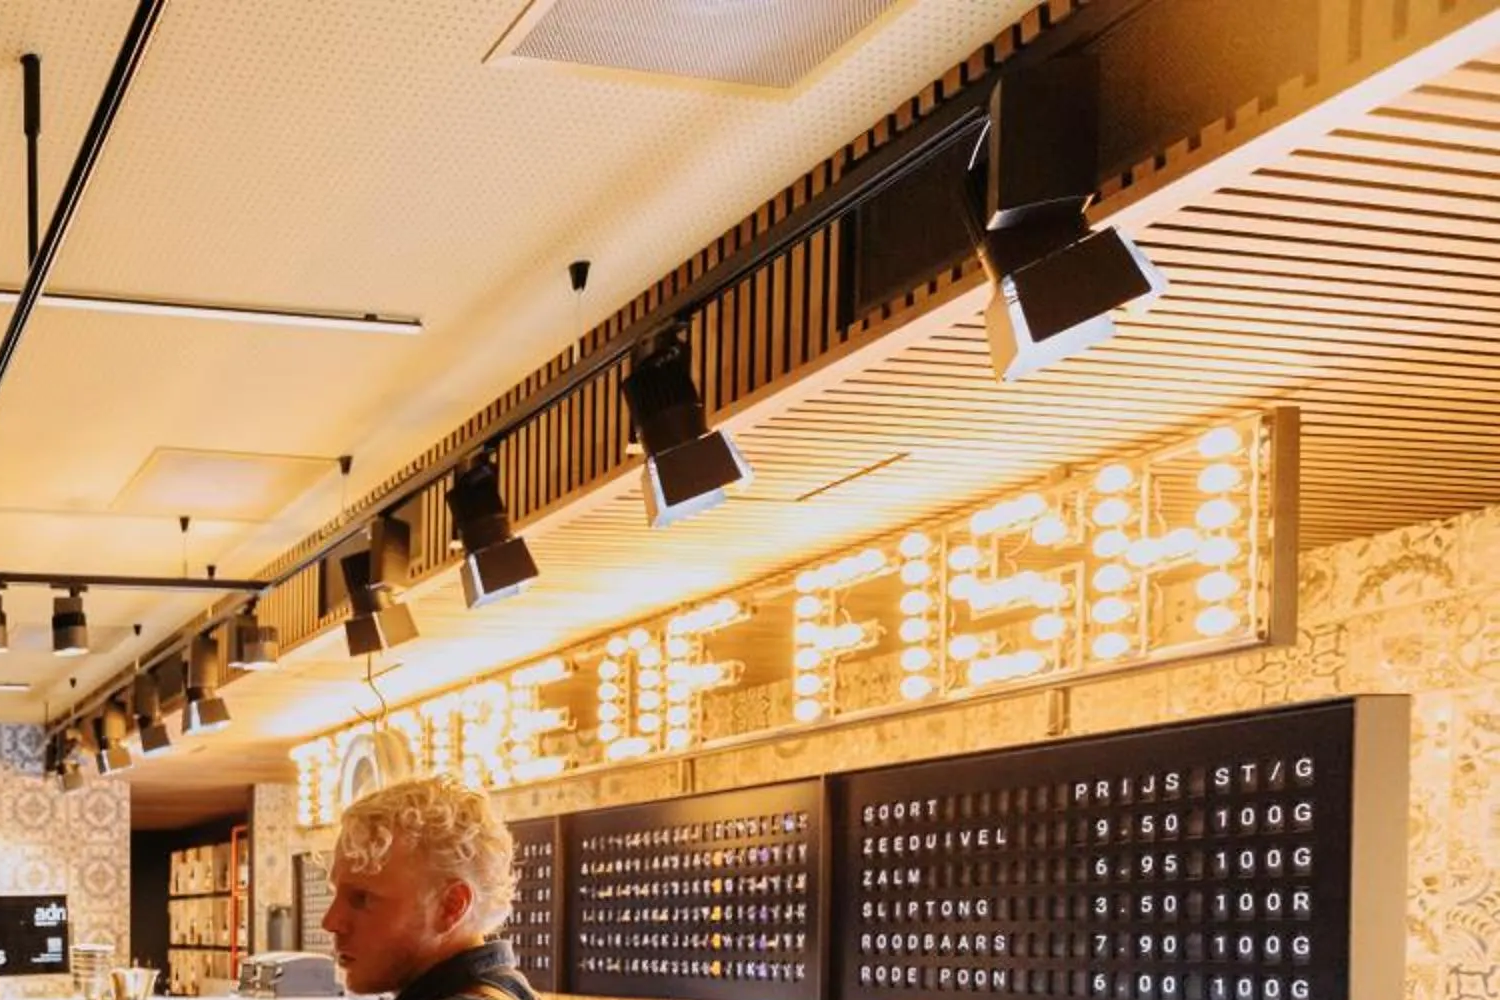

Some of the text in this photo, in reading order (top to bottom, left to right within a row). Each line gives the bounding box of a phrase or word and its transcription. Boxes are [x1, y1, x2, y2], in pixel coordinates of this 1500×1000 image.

[291, 425, 1242, 826] THTRE OF FISH
[863, 757, 1313, 823] SOORT PRIJS ST/G
[863, 802, 1312, 855] ZEEDUIVEL 9.50 100G
[862, 846, 1312, 887] ZALM 6.95 100G
[862, 899, 989, 918] SLIPTONG
[1095, 893, 1177, 914] 3.50
[861, 932, 1311, 956] ROODBAARS 7.90 100G
[861, 965, 1310, 999] RODE POON 6.00 100G
